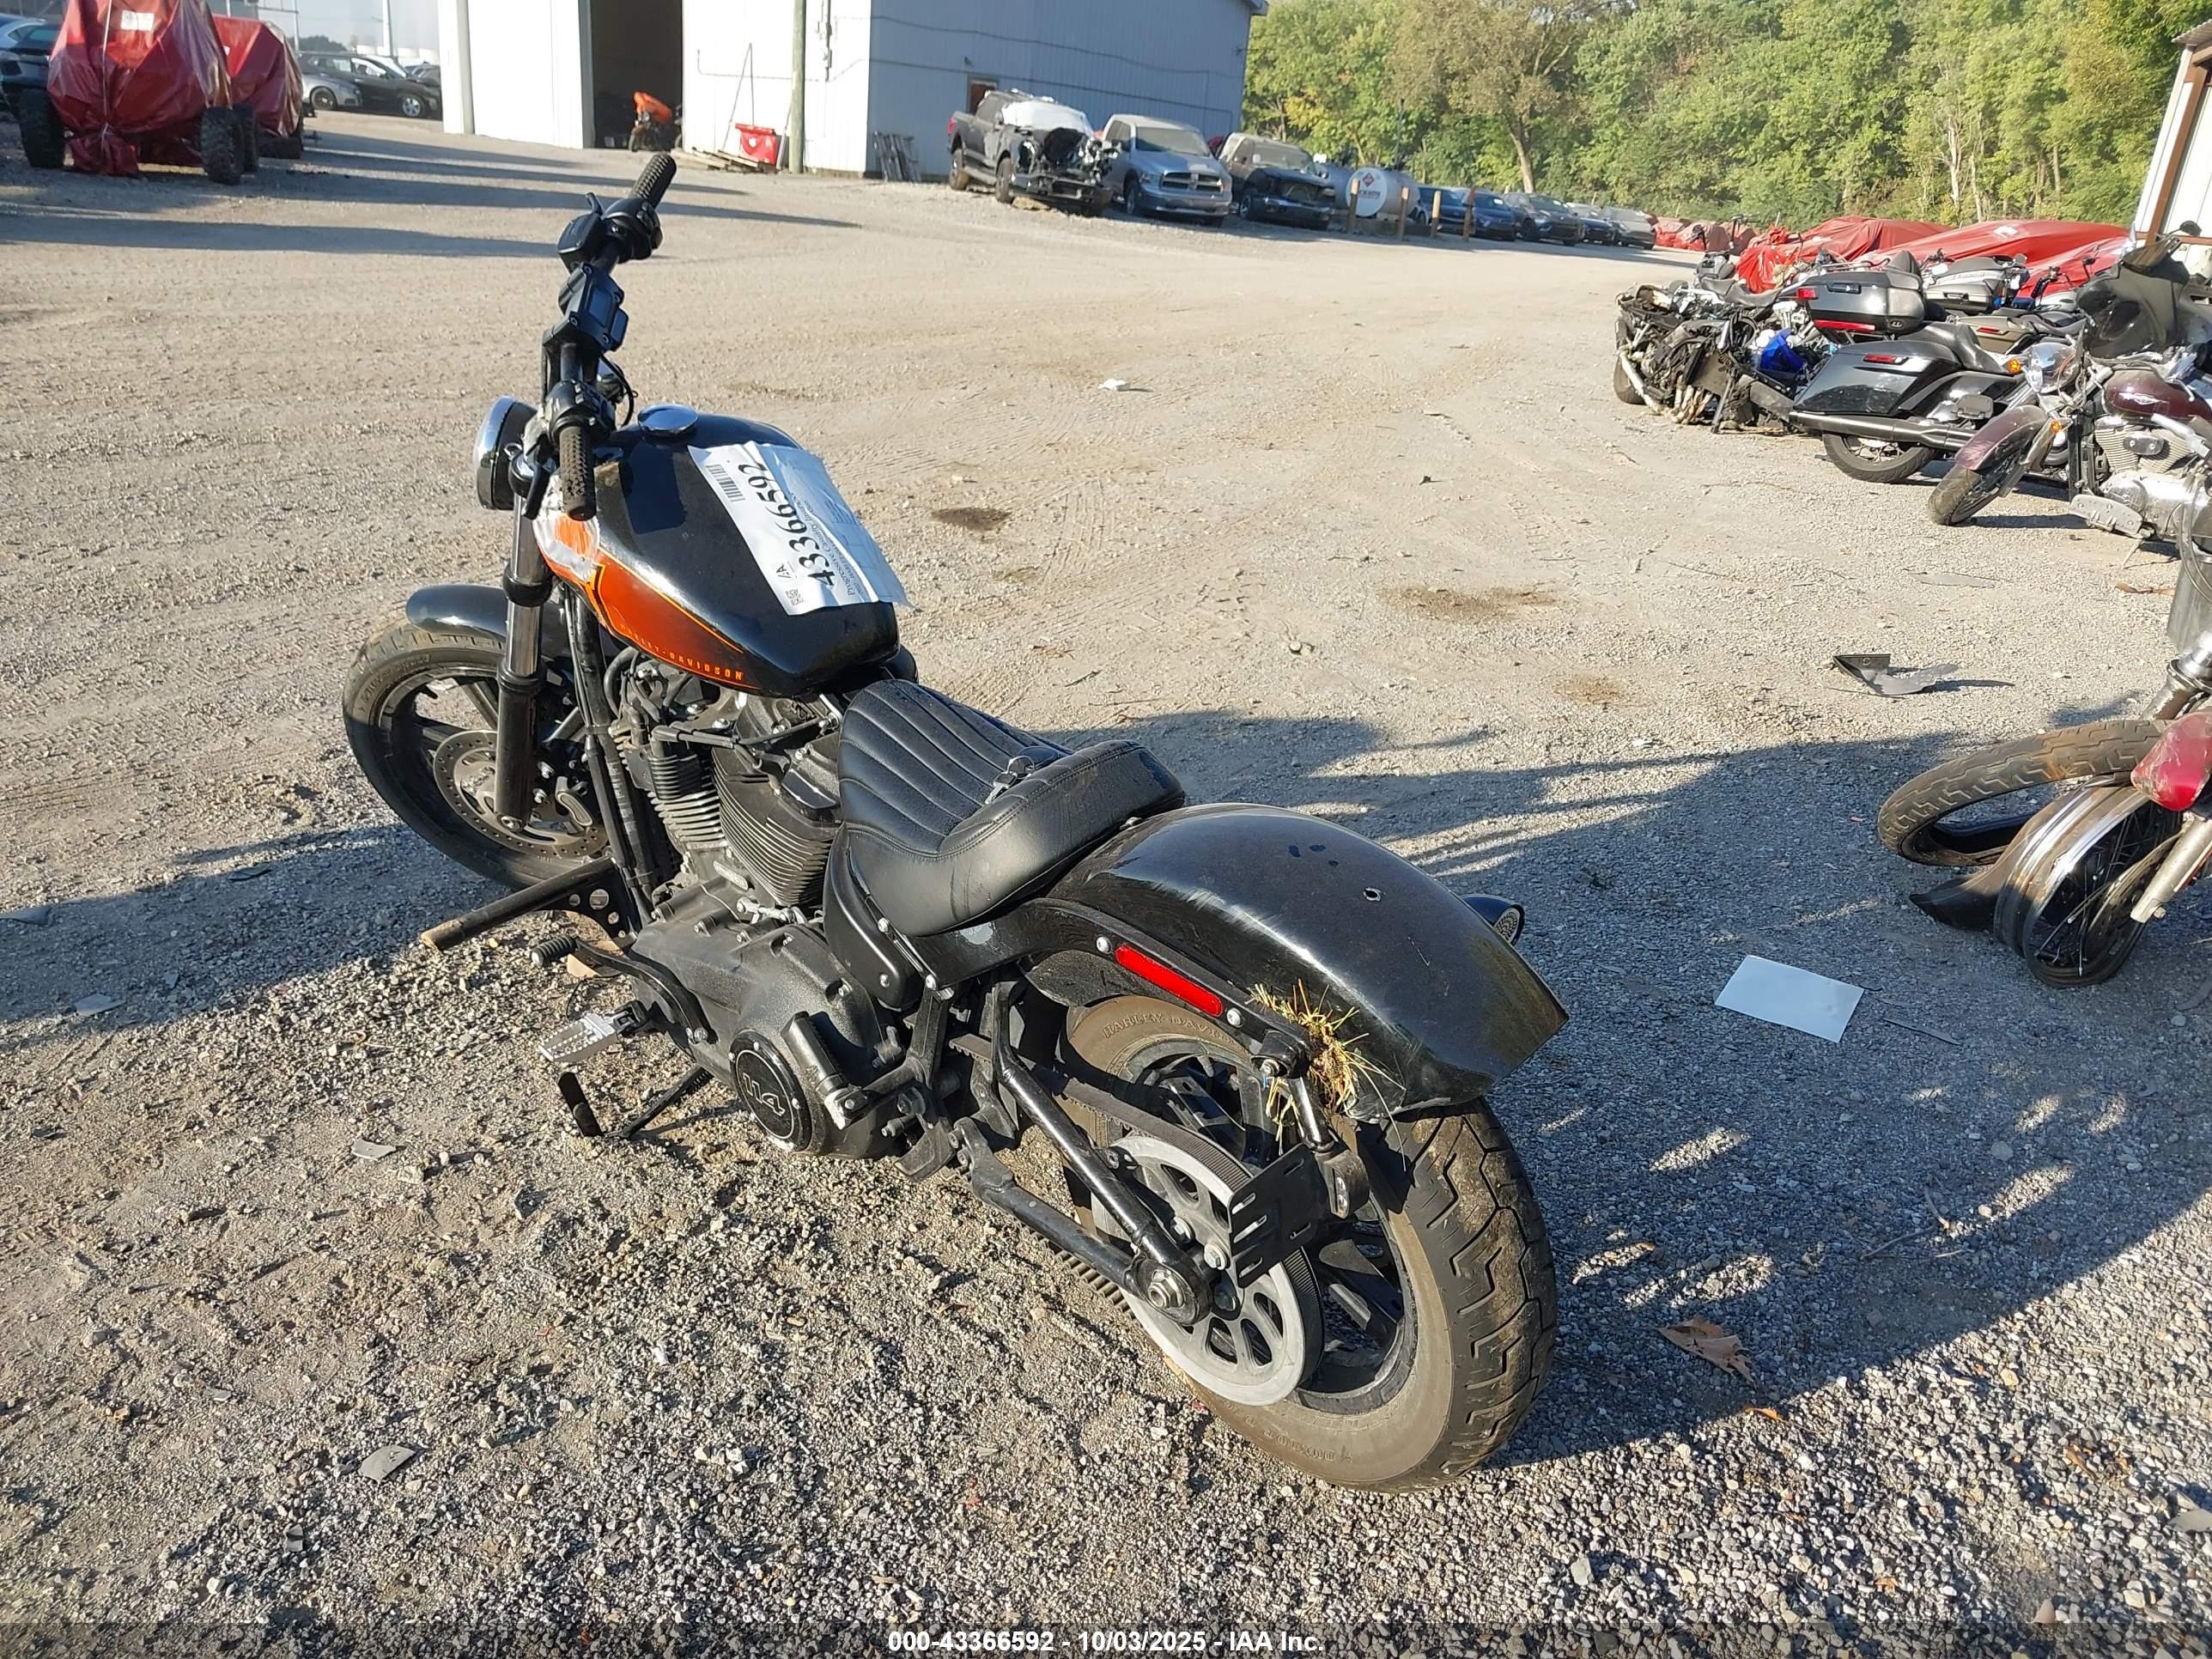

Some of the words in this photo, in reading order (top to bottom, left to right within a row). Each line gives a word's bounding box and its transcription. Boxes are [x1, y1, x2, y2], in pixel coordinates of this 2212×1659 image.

[738, 464, 835, 586] 43366592
[829, 554, 855, 596] Progressive
[619, 623, 743, 681] HARLEY-DAVIDSON
[742, 1072, 786, 1116] 114
